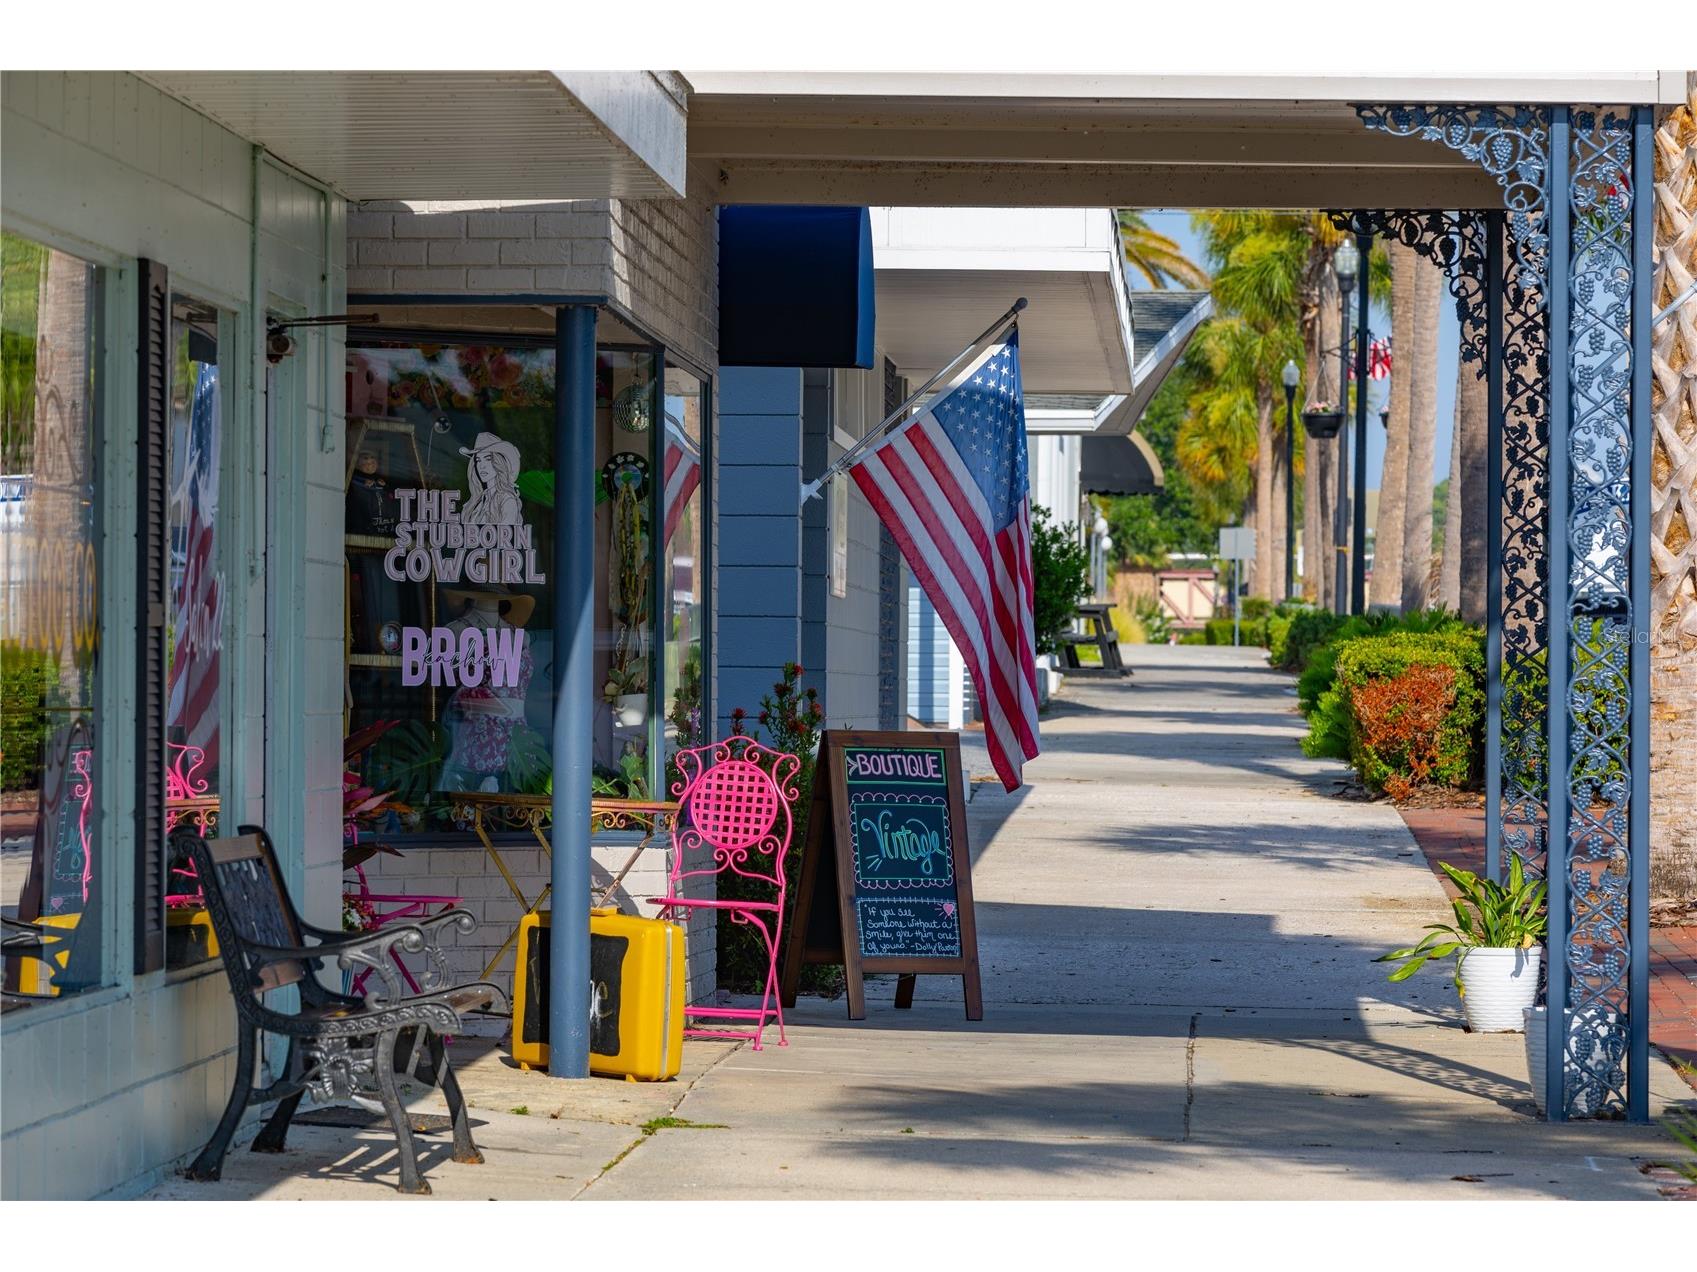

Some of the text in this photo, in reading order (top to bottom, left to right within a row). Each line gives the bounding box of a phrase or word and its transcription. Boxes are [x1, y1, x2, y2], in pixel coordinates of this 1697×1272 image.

[394, 488, 461, 523] THE
[394, 522, 533, 550] STUBBORN
[384, 548, 546, 584] COWGIRL
[402, 626, 524, 688] BROW
[856, 754, 942, 778] BOUTIQUE
[861, 810, 946, 875] Vintage
[880, 908, 896, 922] you
[942, 921, 953, 929] a
[896, 929, 914, 943] give
[914, 930, 937, 942] them
[937, 932, 957, 940] one
